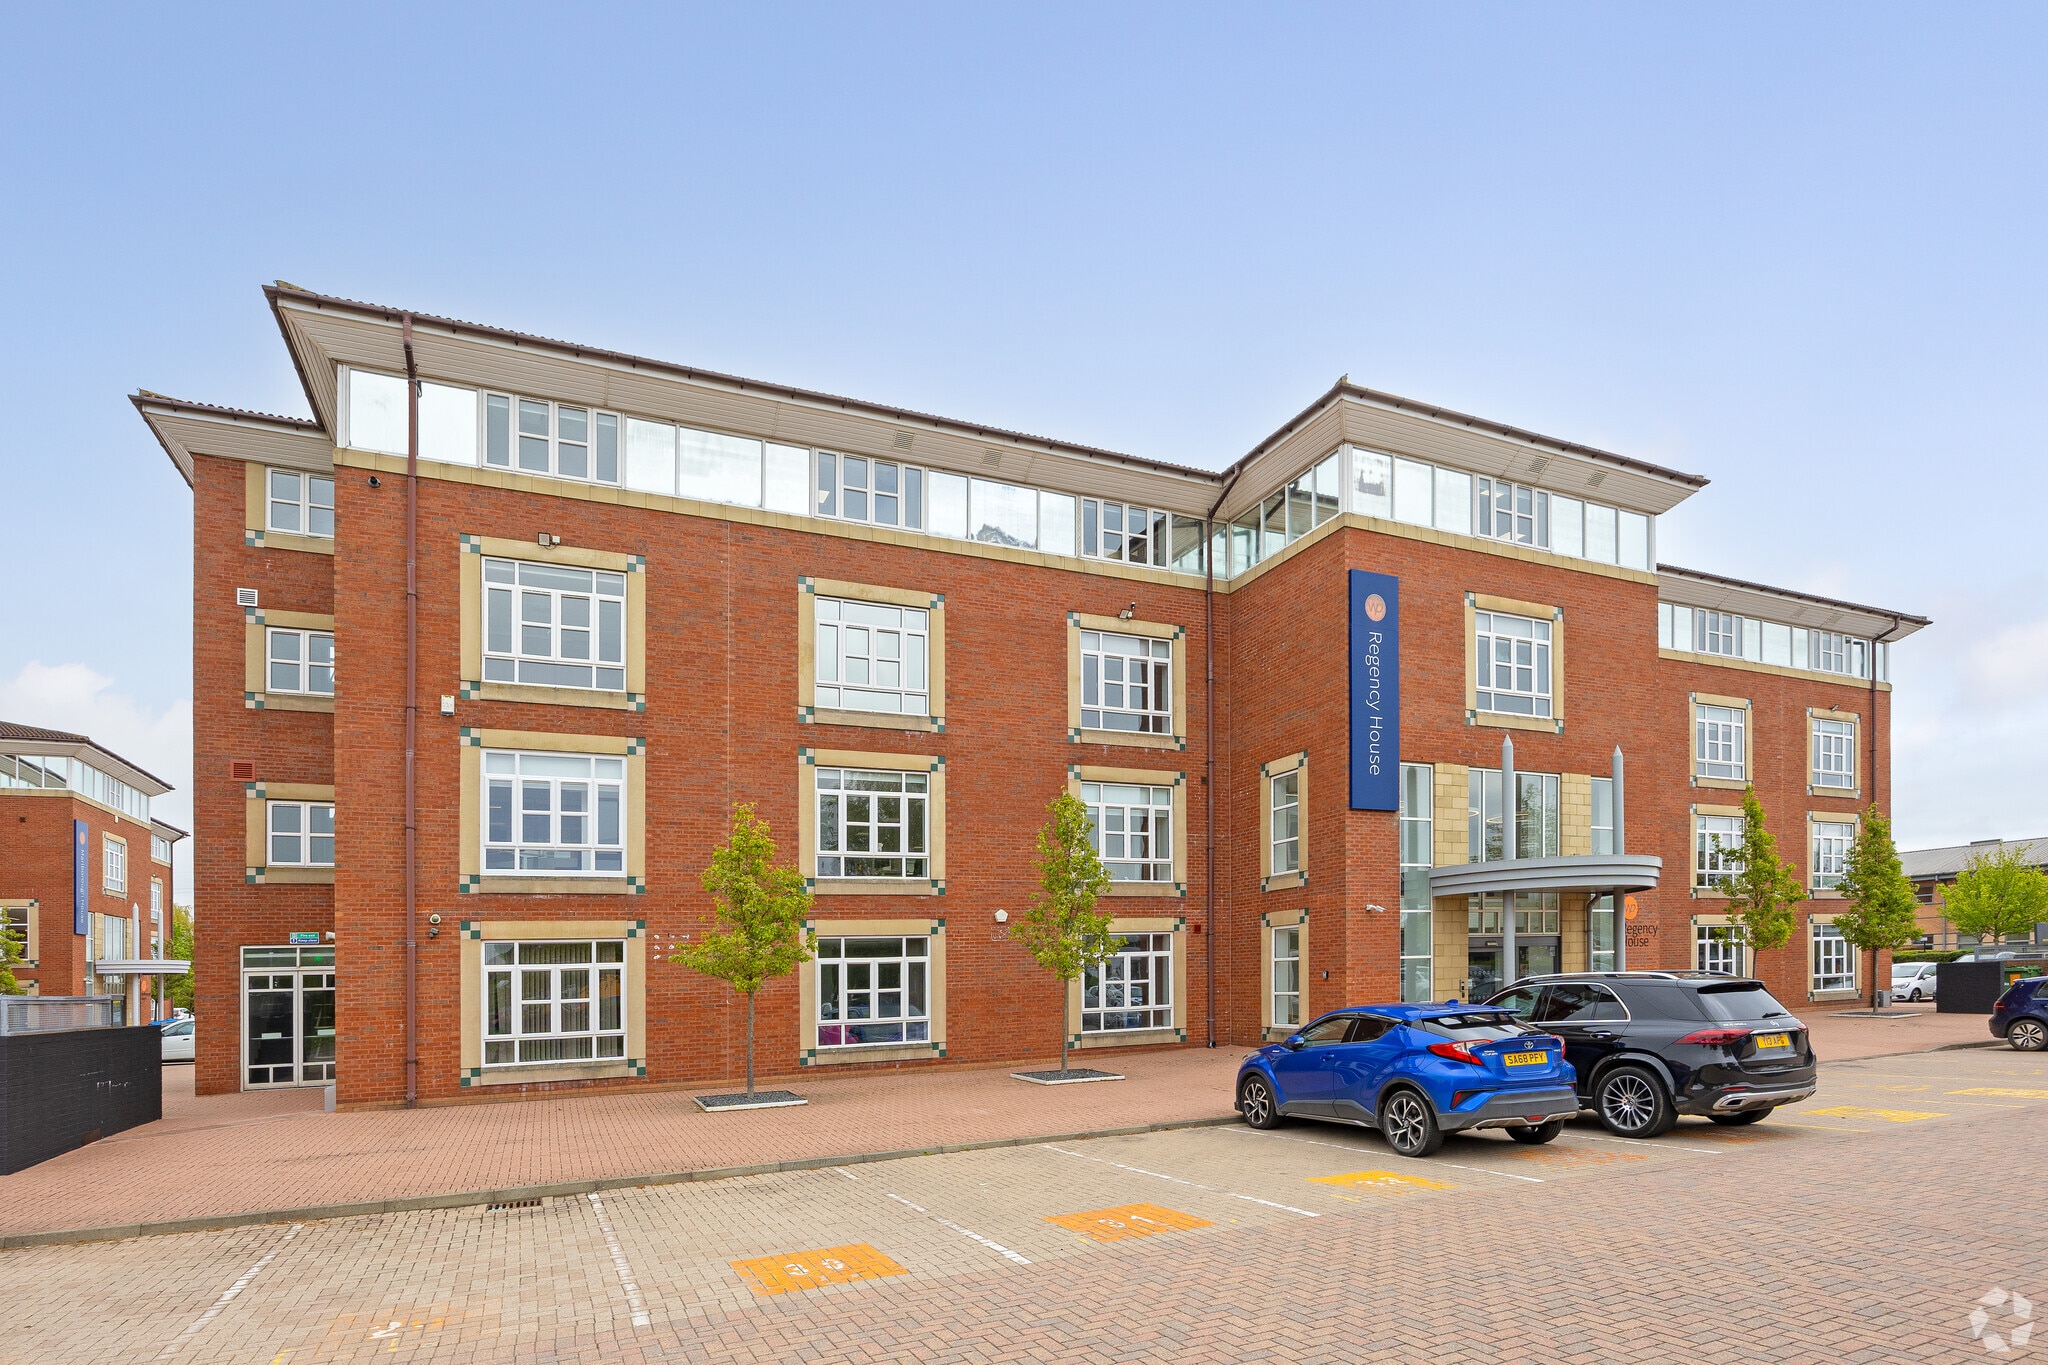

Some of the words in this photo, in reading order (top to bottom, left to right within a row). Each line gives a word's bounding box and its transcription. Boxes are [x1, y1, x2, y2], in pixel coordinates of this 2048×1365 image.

[1365, 631, 1383, 711] Regency
[1369, 716, 1384, 775] House
[1625, 923, 1658, 938] egency
[1508, 1053, 1528, 1064] SA68
[1529, 1053, 1544, 1063] PFY
